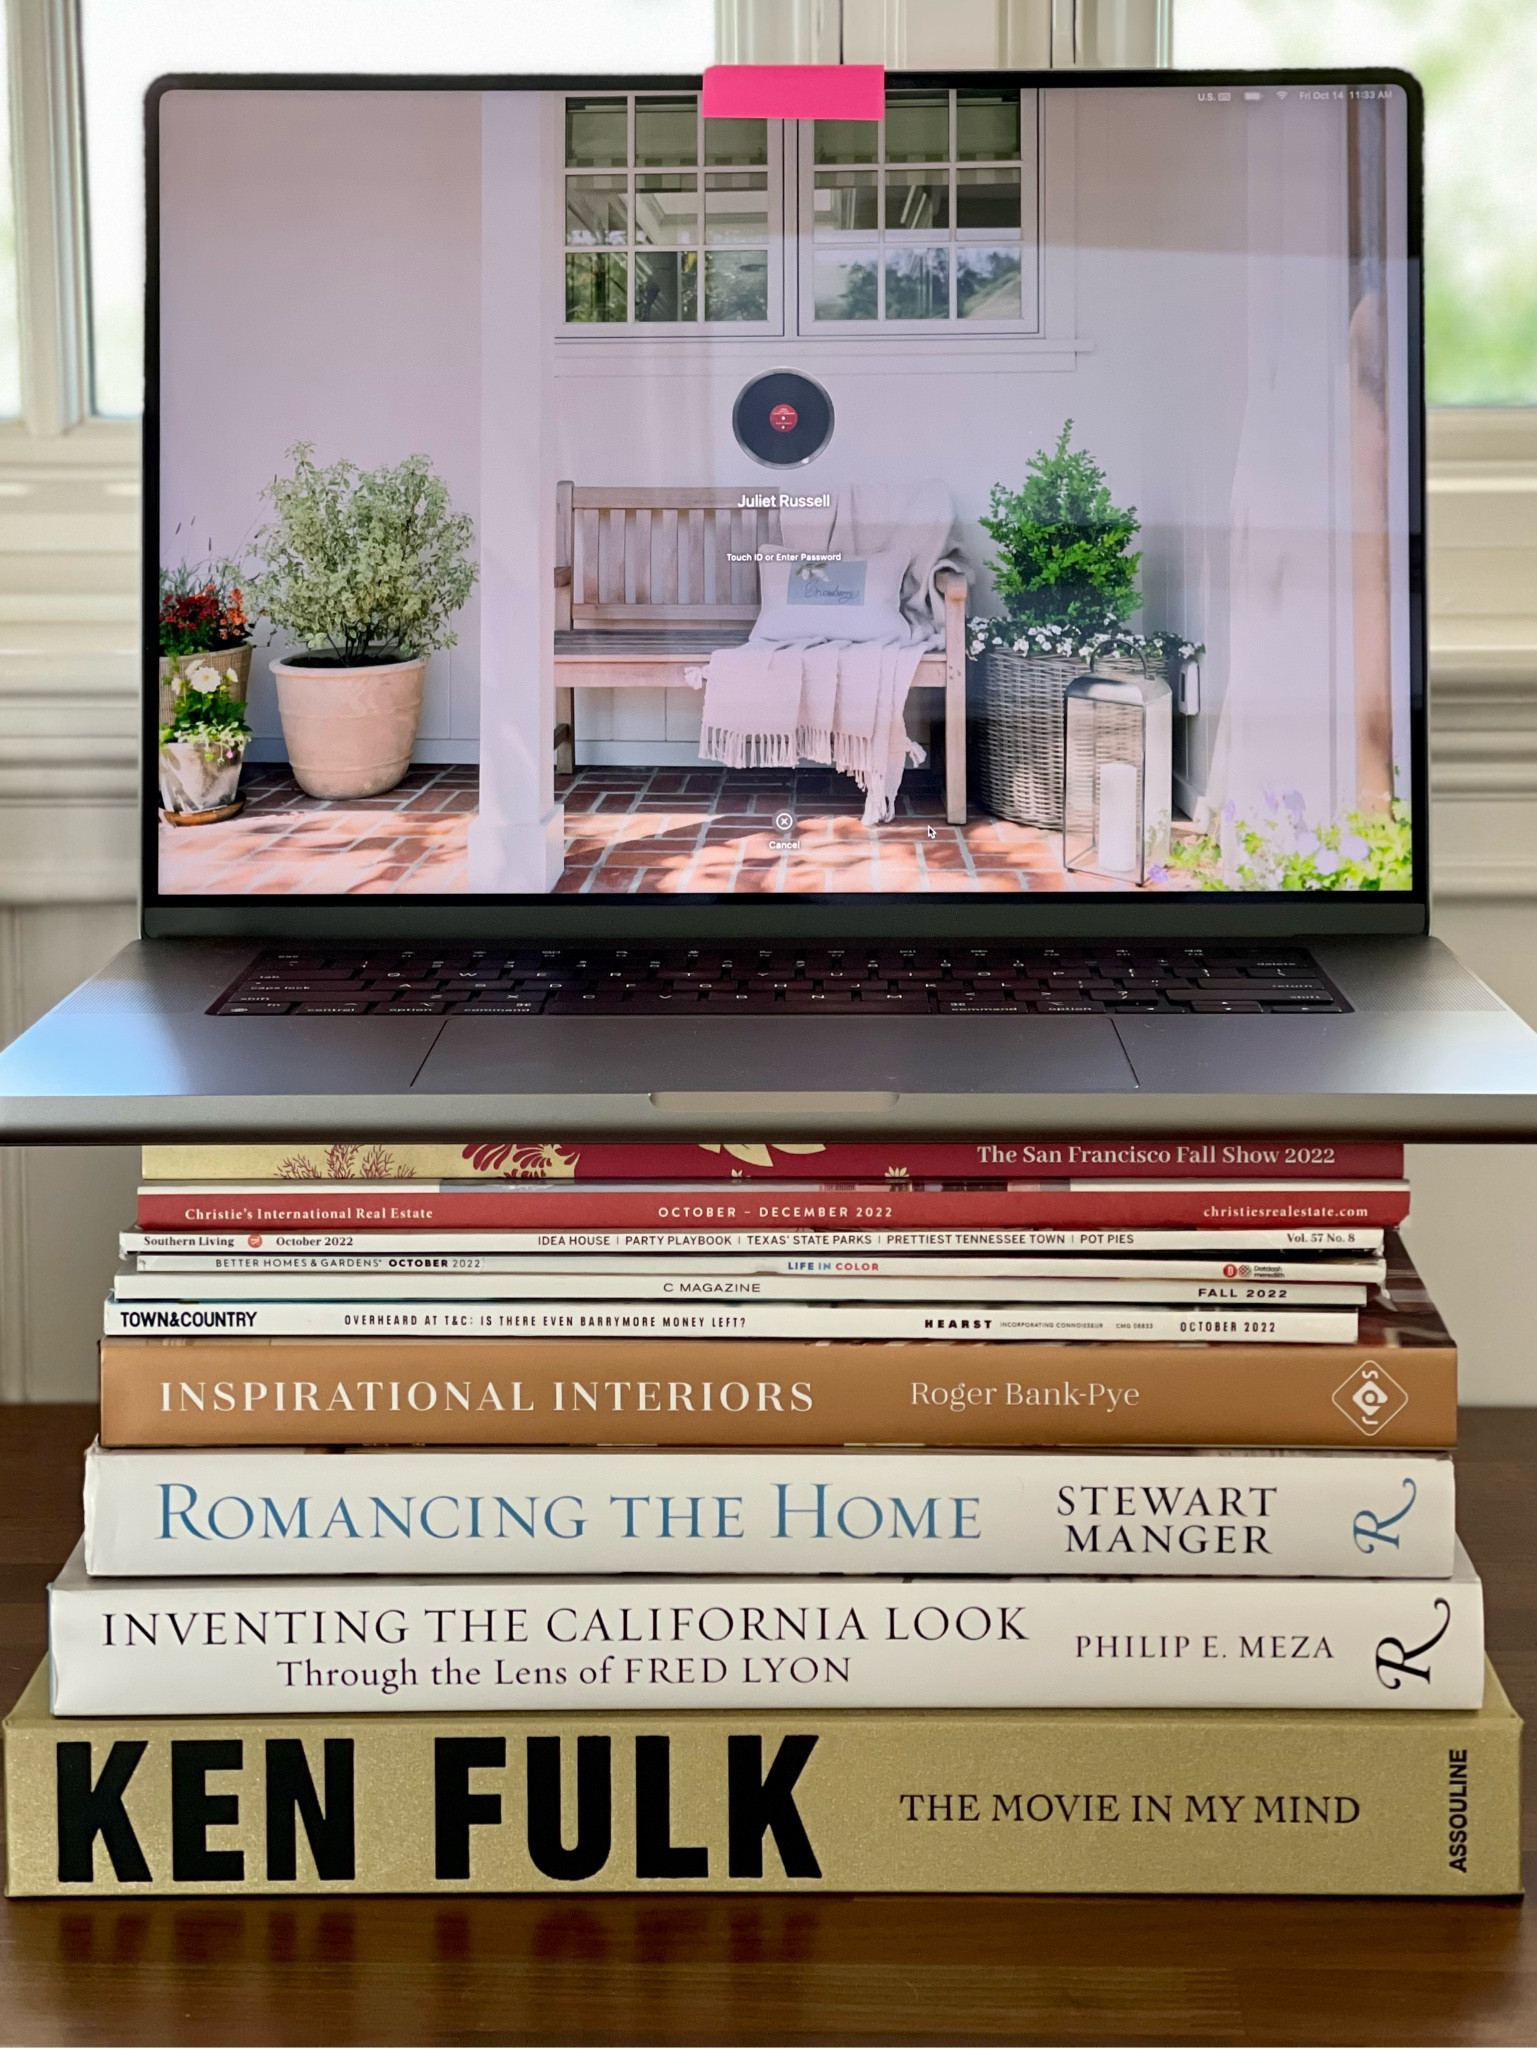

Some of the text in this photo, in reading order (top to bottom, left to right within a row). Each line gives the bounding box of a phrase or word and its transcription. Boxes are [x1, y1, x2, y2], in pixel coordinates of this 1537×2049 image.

[1197, 93, 1216, 101] U.S.
[1299, 91, 1343, 100] Fri Oct 14
[1349, 91, 1393, 100] 11:33 AM
[738, 494, 830, 508] Juliet Russell
[727, 553, 752, 561] Touch
[754, 553, 763, 561] ID
[776, 553, 798, 561] Enter
[800, 553, 842, 561] Password
[768, 841, 800, 849] Cancel
[977, 1146, 1335, 1165] The San Francisco Fall Show 2022
[185, 1207, 433, 1222] Christie's International Real Estate
[658, 1206, 893, 1219] OCTOBER DECEMBER 2022
[1204, 1205, 1368, 1219] christiesrealestate.com
[143, 1236, 200, 1248] Southern
[203, 1235, 235, 1249] Living
[276, 1235, 320, 1248] October
[324, 1236, 354, 1248] 2022
[537, 1233, 1135, 1247] IDEA HOUSE PARTY PLAYBOOK TEXAS' STATE PARKS PRETTIEST TENNESSEE TOWN POT PIES
[1286, 1232, 1356, 1244] Vol. 57 No. 8
[215, 1258, 260, 1269] BETTER
[264, 1258, 308, 1269] HOMES
[310, 1258, 319, 1269] &
[388, 1258, 449, 1269] OCTOBER
[452, 1257, 481, 1268] 2022
[787, 1260, 879, 1272] LIFE IN COLOR
[663, 1282, 761, 1293] C MAGAZINE
[1198, 1288, 1288, 1299] FALL 2022
[120, 1312, 257, 1328] TOWN&COUNTRY
[344, 1315, 746, 1328] OVERHEARD AT T&C: IS THERE EVEN BARRYMORE MONEY LEFT?
[924, 1319, 993, 1330] HEARST
[1180, 1321, 1276, 1333] OCTOBER 2022
[161, 1382, 812, 1411] INSPIRATIONAL INTERIORS
[912, 1382, 1139, 1412] Roger Bank-Pye
[1058, 1486, 1276, 1516] STEWART
[610, 1496, 744, 1538] THE
[1353, 1478, 1416, 1554] R
[1067, 1525, 1270, 1553] MANGER
[105, 1607, 1028, 1645] INVENTING THE CALIFORNIA LOOK
[1075, 1636, 1335, 1660] PHILIP E. MEZA
[1376, 1598, 1450, 1689] R
[277, 1656, 849, 1694] Through the Lens of FRED LYON
[57, 1735, 822, 1882] KEN FULK
[900, 1794, 1359, 1823] THE MOVIE IN MY MIND
[1449, 1750, 1467, 1873] ASSOULINE
